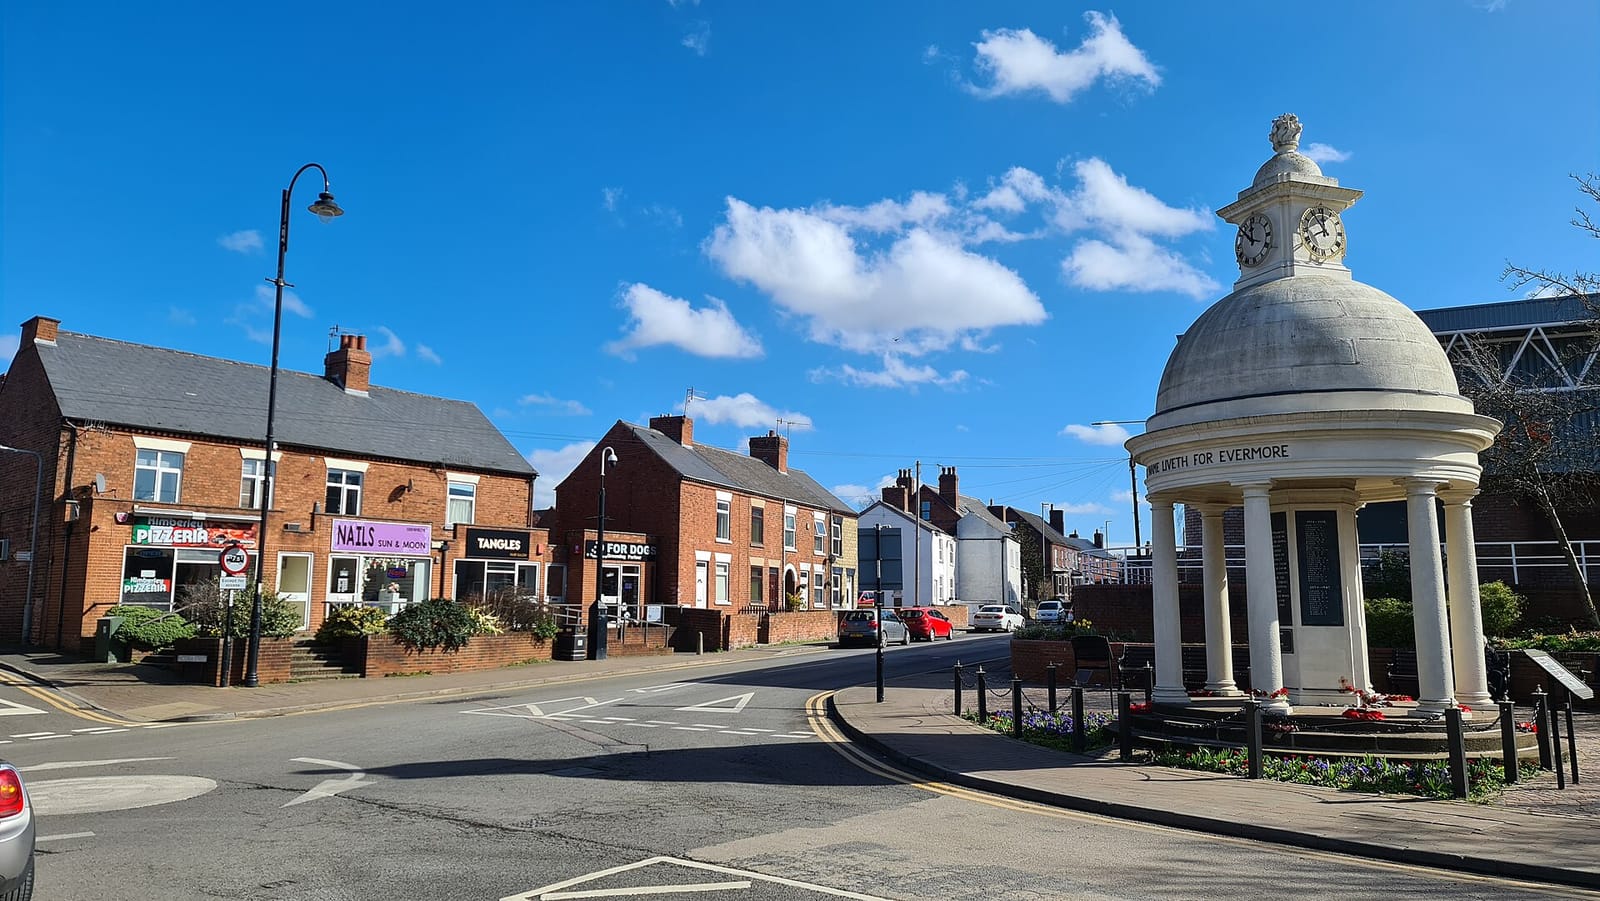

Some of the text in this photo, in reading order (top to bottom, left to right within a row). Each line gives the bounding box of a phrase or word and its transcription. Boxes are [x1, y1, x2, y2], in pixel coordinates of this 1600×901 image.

[1162, 456, 1189, 471] LIVETH
[1193, 452, 1213, 465] FOR
[1219, 444, 1289, 462] EVERMORE
[148, 516, 204, 528] Kimberley
[137, 529, 208, 544] PIZZERIA
[337, 525, 426, 549] NAILS SUN & MOON
[477, 537, 521, 551] TANGLES
[607, 543, 627, 554] FOR
[629, 544, 657, 555] DOGS
[124, 583, 167, 593] PIZZERIA
